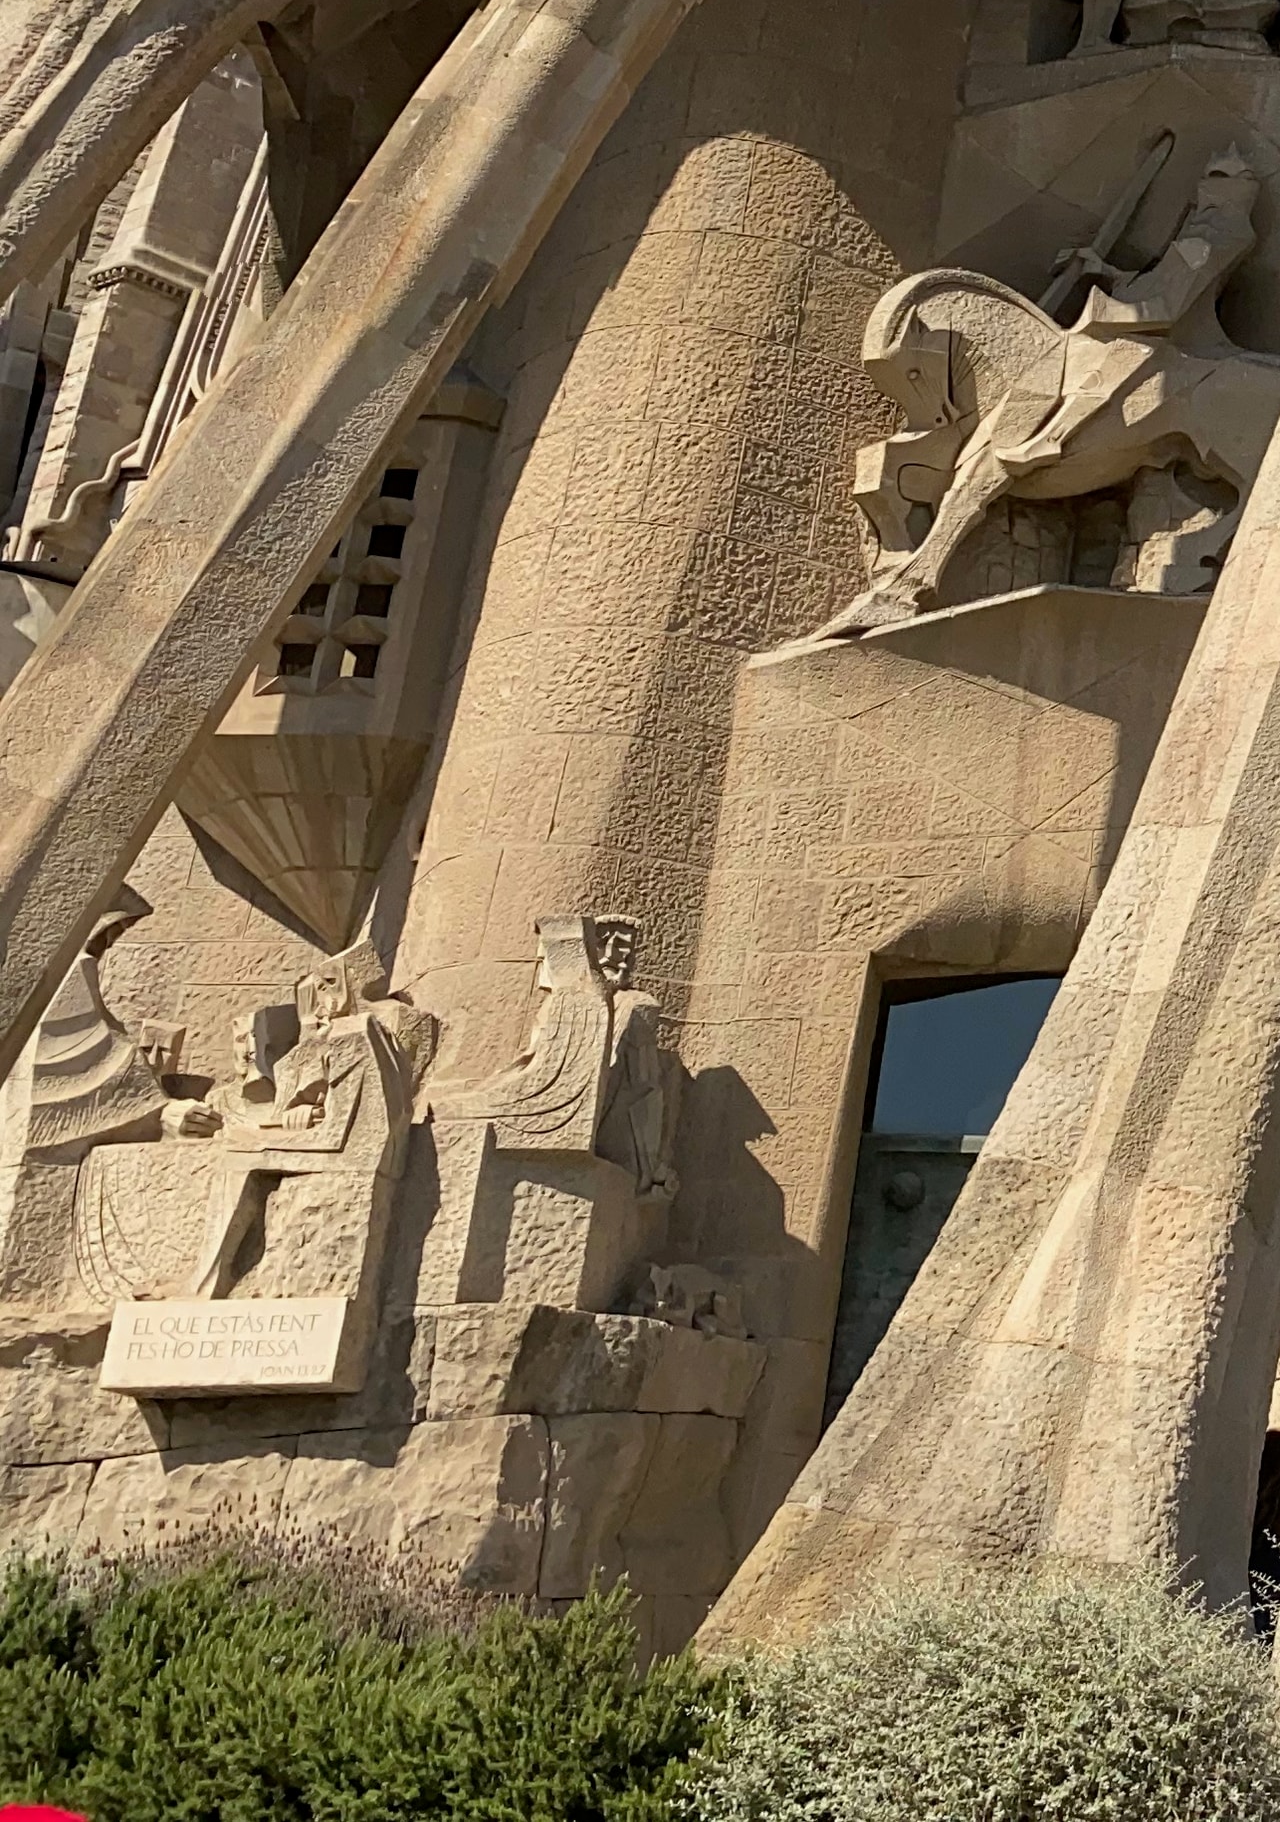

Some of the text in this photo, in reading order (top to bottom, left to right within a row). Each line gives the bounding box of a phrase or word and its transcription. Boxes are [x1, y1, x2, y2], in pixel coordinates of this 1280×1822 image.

[132, 1317, 154, 1336] EL
[159, 1316, 201, 1342] QUE
[268, 1313, 323, 1333] FENT
[199, 1341, 225, 1359] DE
[230, 1339, 300, 1358] PRESSA
